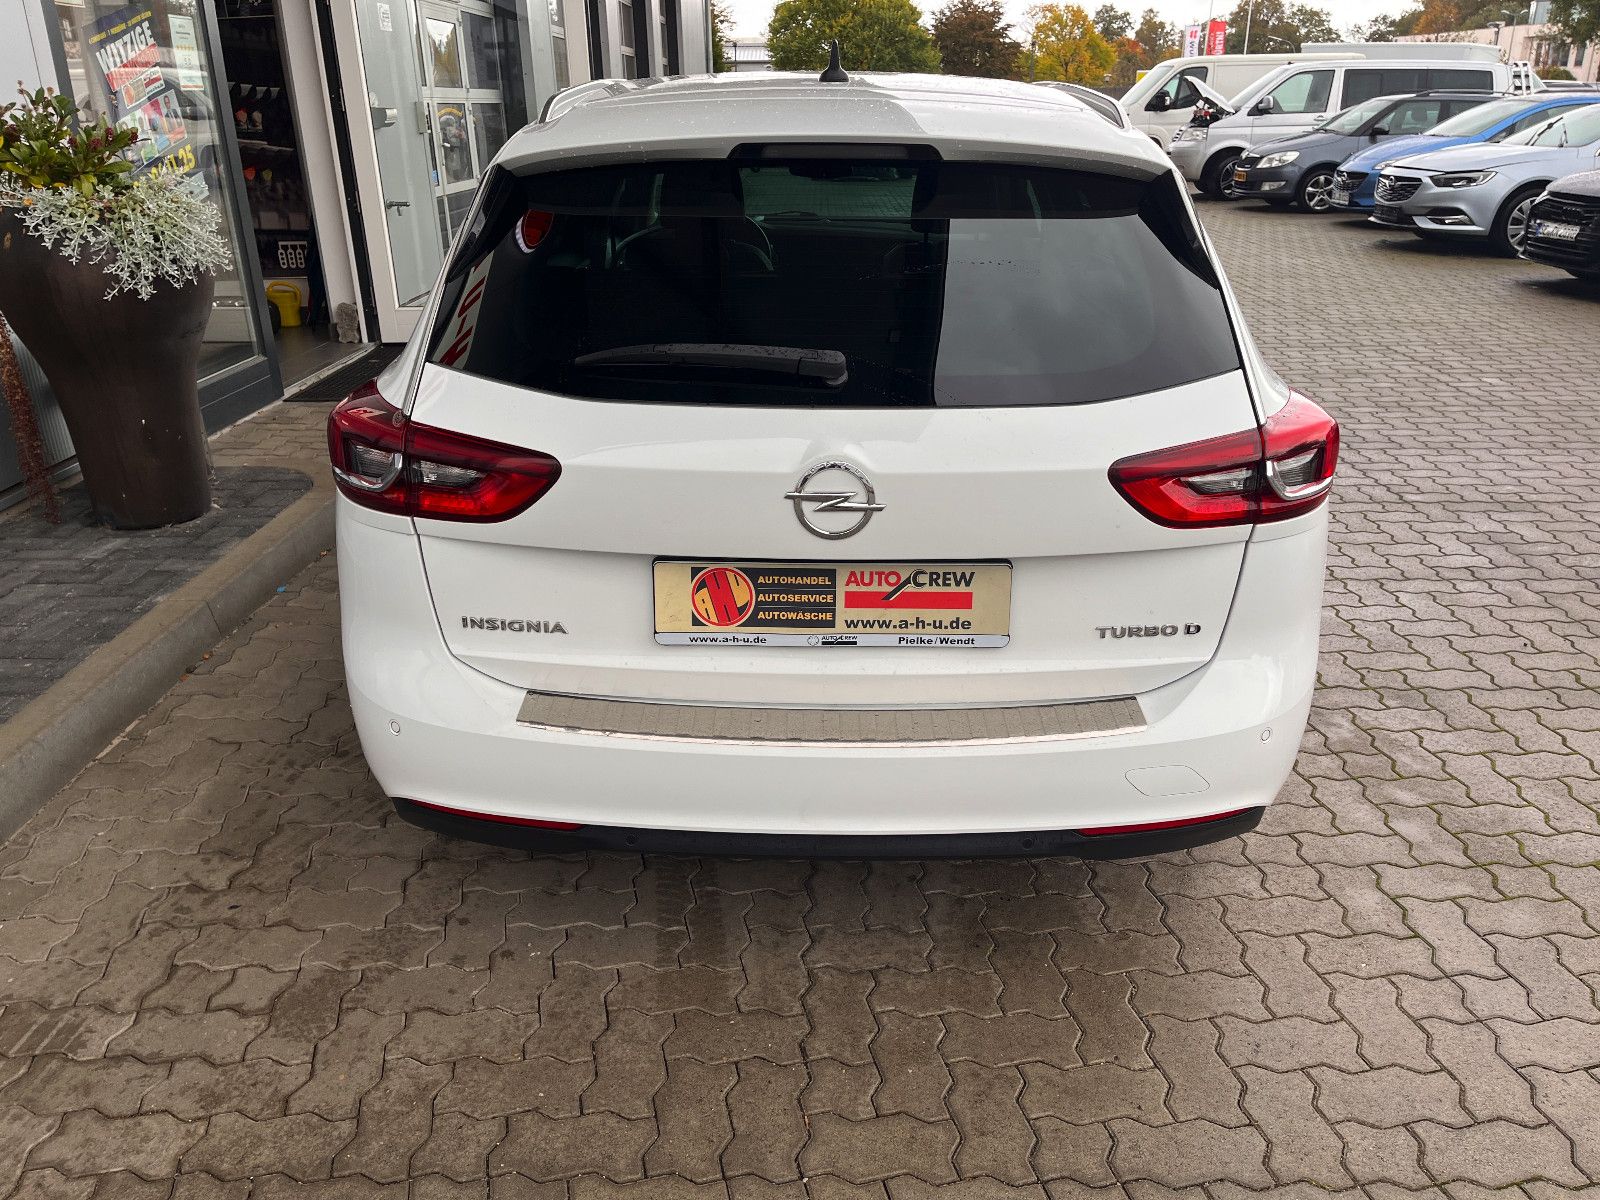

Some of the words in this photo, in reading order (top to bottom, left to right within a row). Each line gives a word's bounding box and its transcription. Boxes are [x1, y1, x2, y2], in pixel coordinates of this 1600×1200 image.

[95, 20, 155, 75] WITZIGE
[757, 575, 832, 585] AUTOHANDEL
[844, 570, 902, 587] AUTO
[911, 569, 976, 588] CREW
[757, 593, 834, 603] AUTOSERVICE
[757, 610, 833, 620] AUTOWÄSCHE
[461, 616, 568, 635] INSIGNIA
[844, 617, 972, 630] www.a-h-u.de
[1095, 624, 1179, 639] TURBO
[1184, 622, 1202, 635] D
[689, 636, 767, 645] www.a-h-u.de
